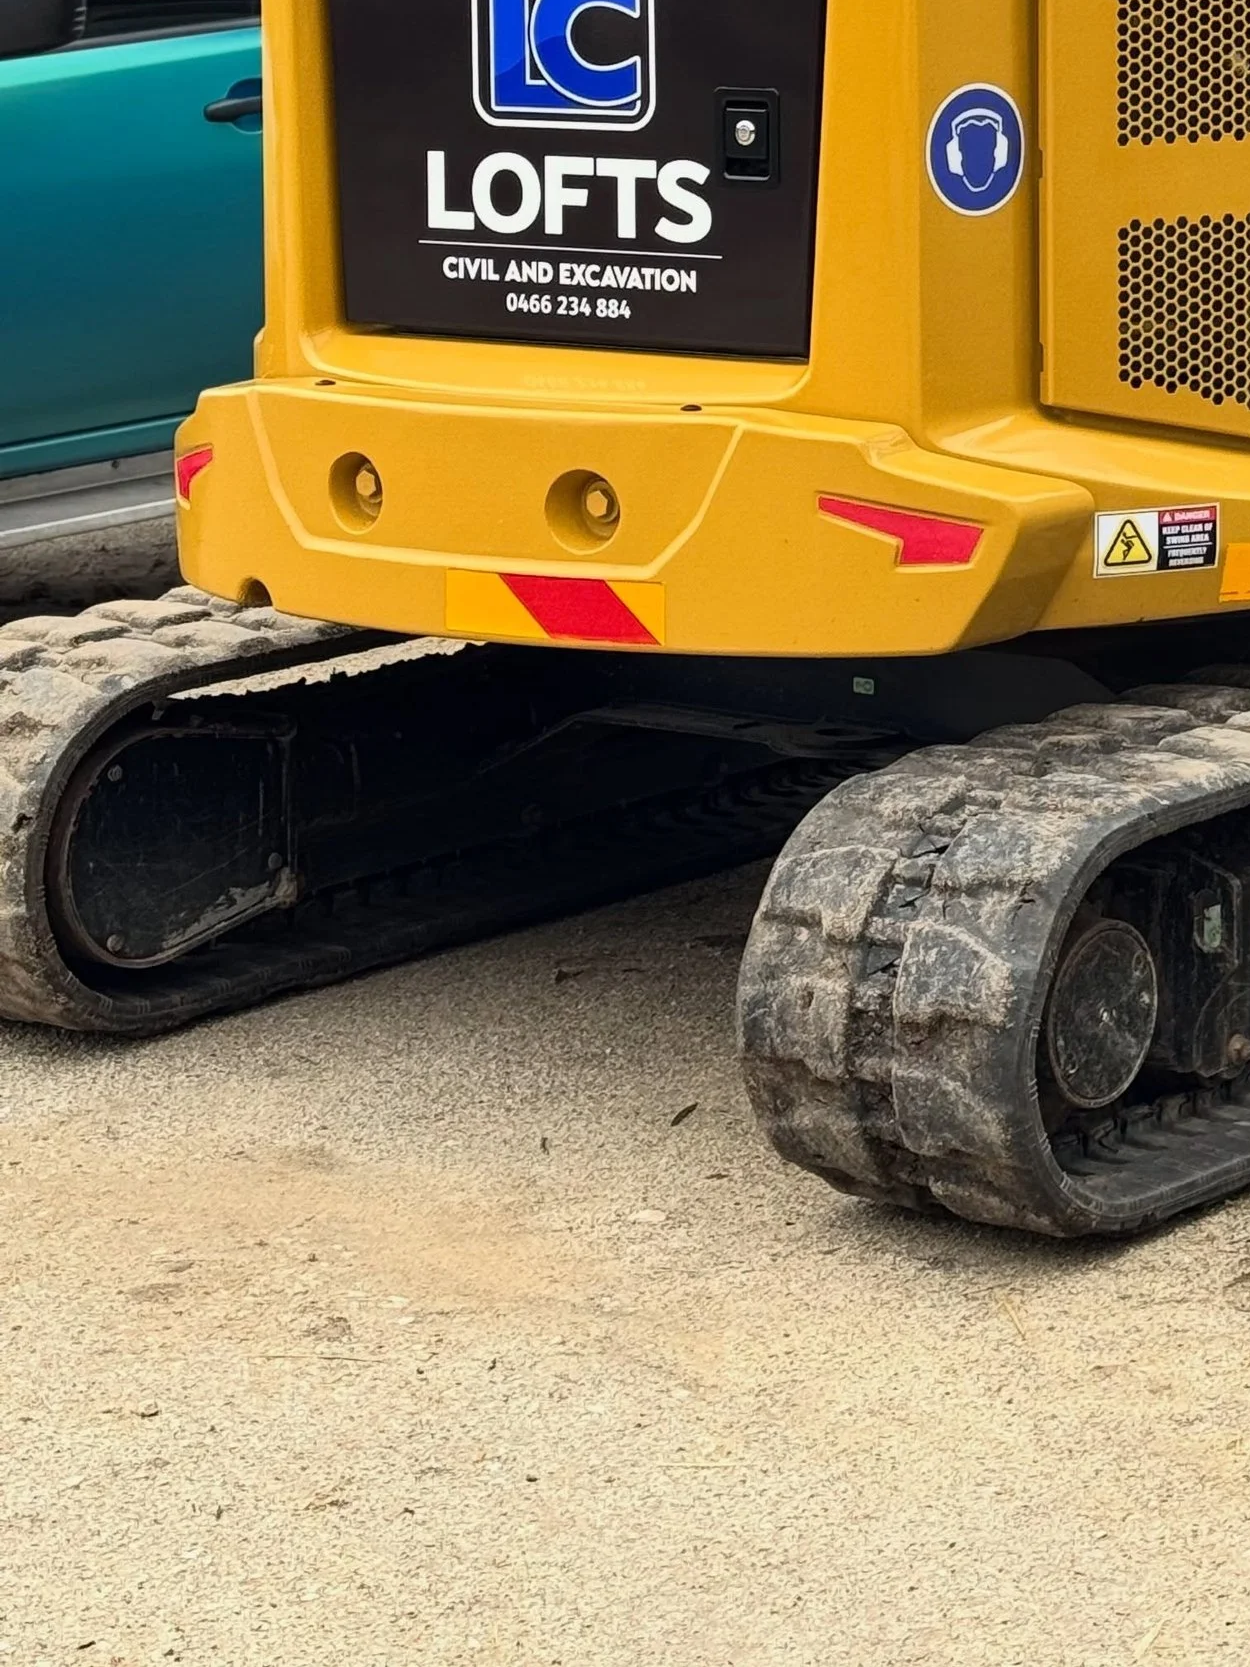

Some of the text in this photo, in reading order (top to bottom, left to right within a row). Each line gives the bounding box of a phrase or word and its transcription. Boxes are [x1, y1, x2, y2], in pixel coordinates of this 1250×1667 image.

[427, 150, 712, 244] LOFTS
[442, 256, 697, 294] CIVIL AND EXCAVATION
[506, 293, 631, 320] 0466 234 884
[1162, 525, 1180, 535] KEEP
[1181, 523, 1203, 534] CLEAR
